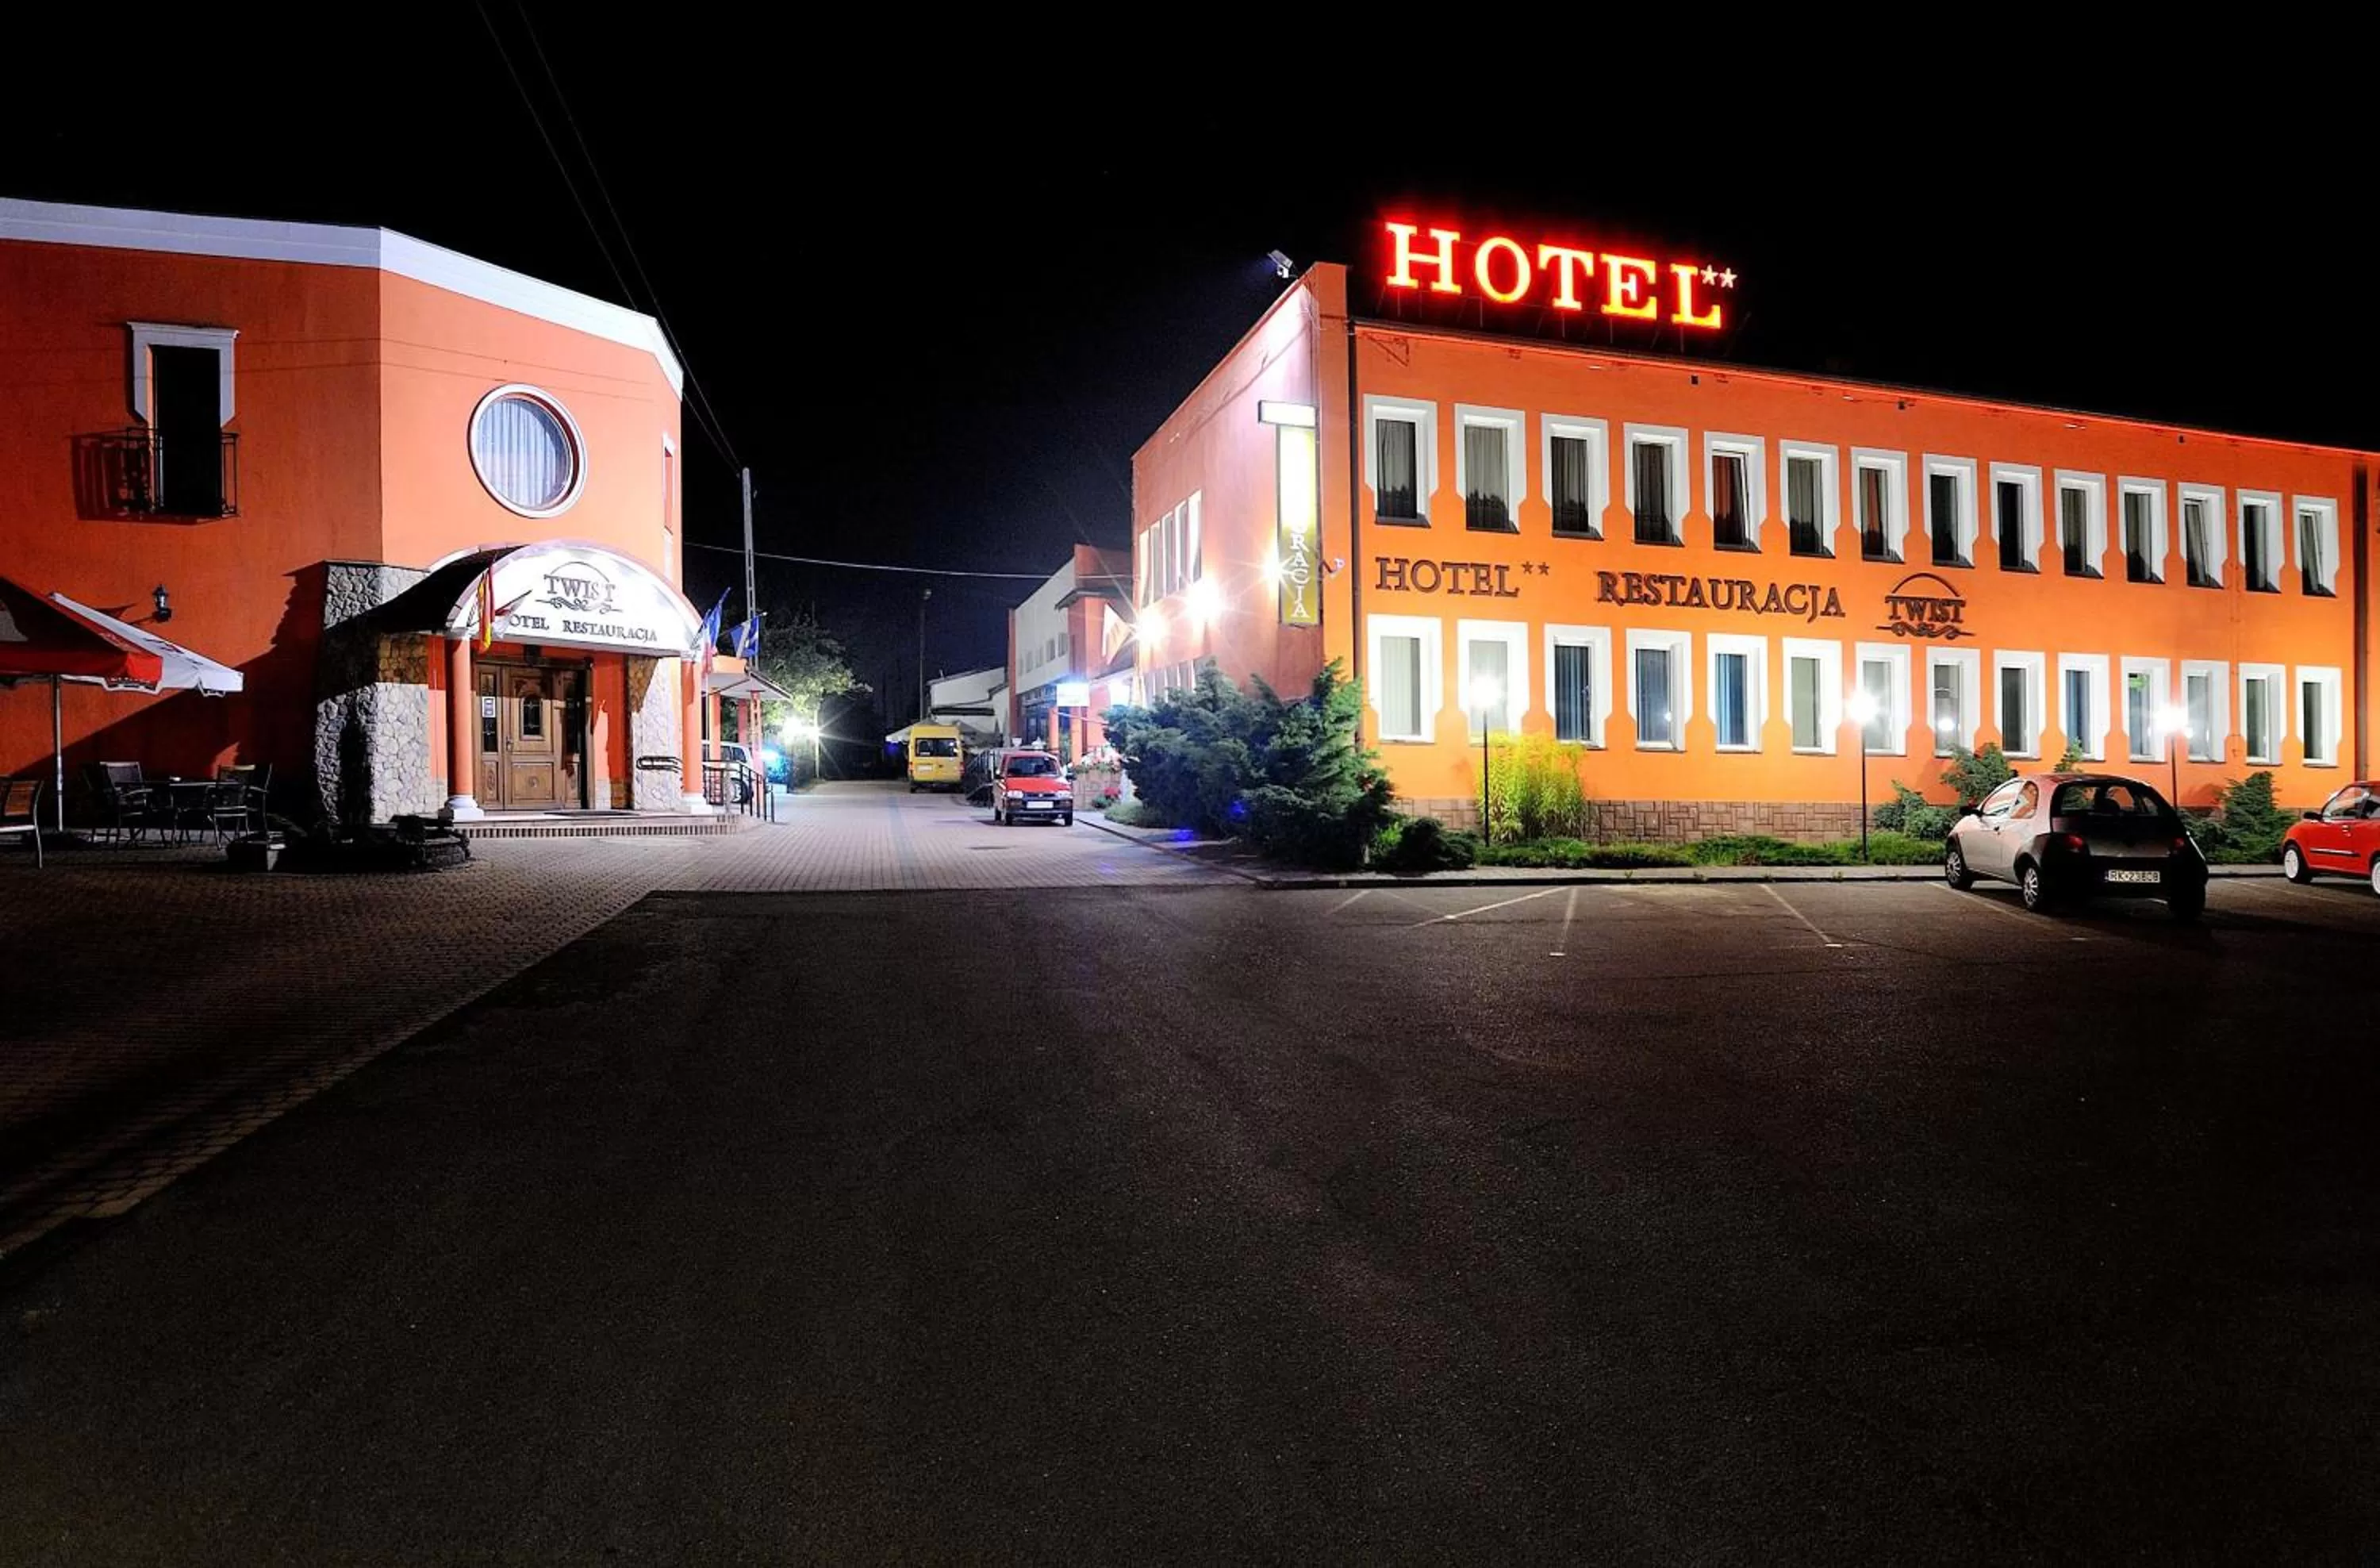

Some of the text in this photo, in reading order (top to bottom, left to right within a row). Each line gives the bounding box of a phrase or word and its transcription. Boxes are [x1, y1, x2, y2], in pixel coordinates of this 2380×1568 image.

[1385, 221, 1722, 329] HOTEL
[543, 574, 616, 603] TWIST
[1375, 556, 1520, 598] HOTEL
[1596, 571, 1846, 623] RESTAURACJA
[1884, 596, 1967, 623] TWIST
[509, 613, 658, 642] OTEL RESTAURACJA
